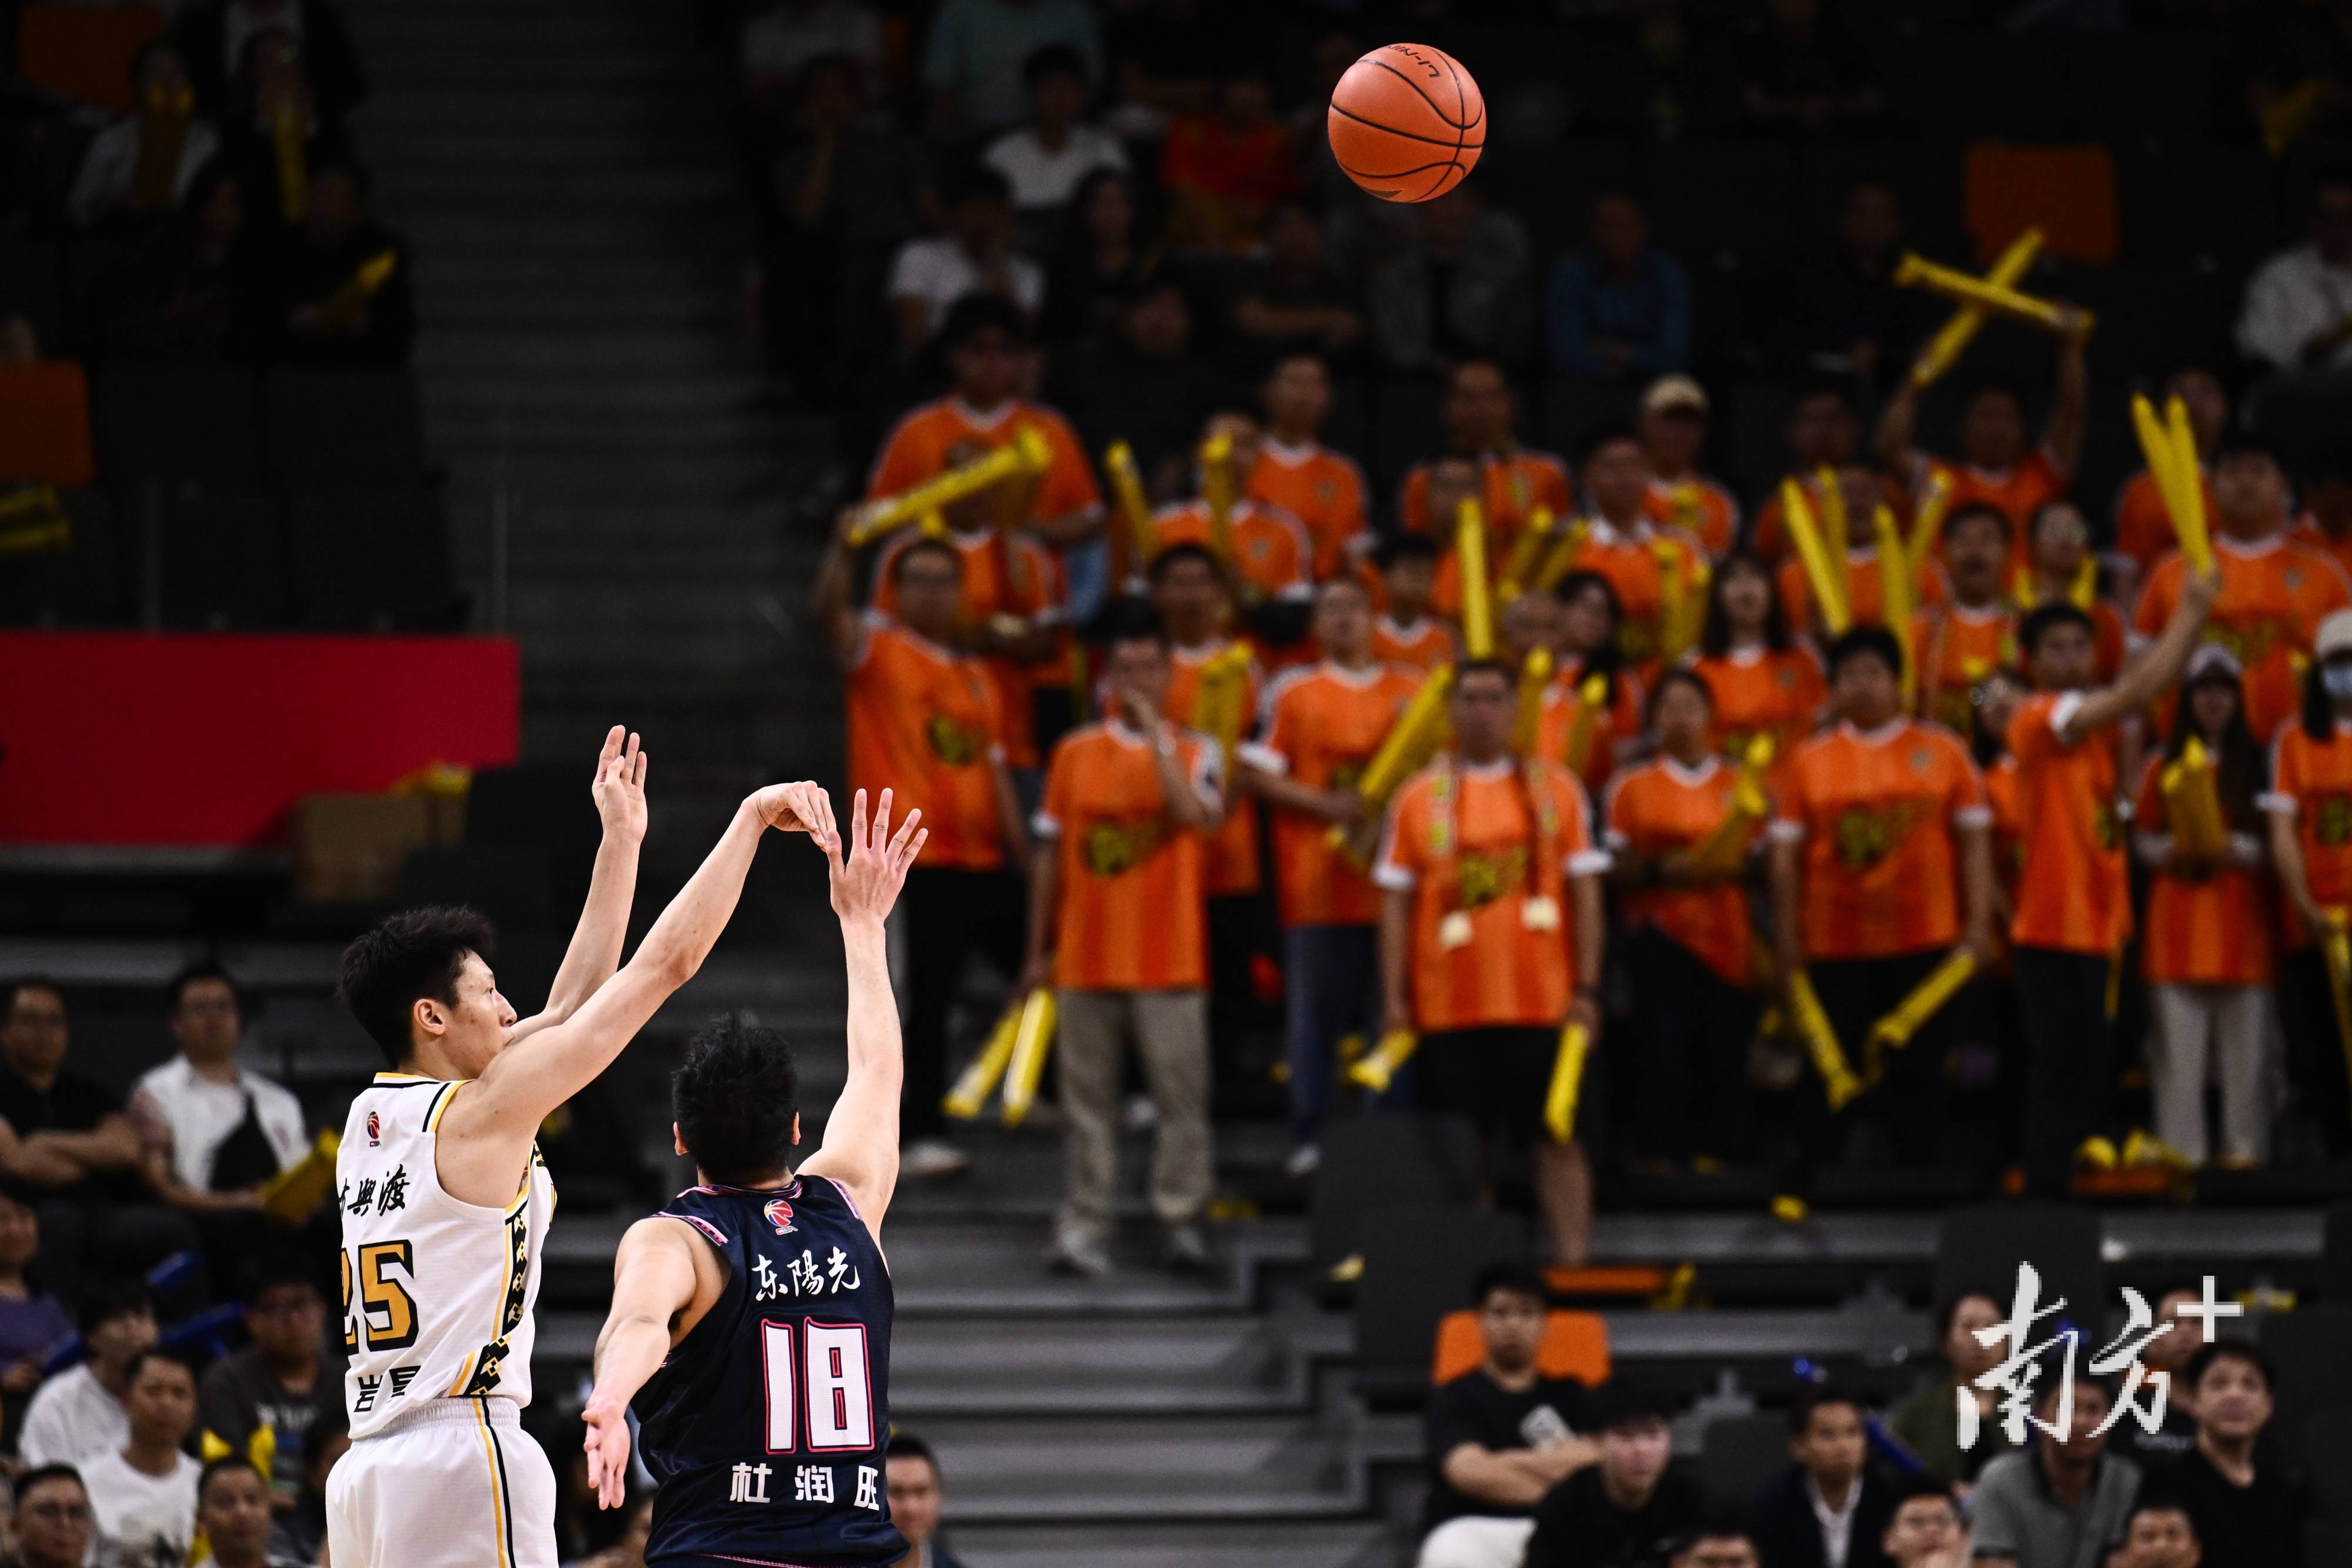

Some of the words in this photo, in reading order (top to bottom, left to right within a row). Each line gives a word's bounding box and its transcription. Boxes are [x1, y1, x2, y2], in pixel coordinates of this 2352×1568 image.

[776, 1225, 799, 1235] CBA
[760, 1316, 876, 1455] 18
[729, 1462, 880, 1511] 杜润旺
